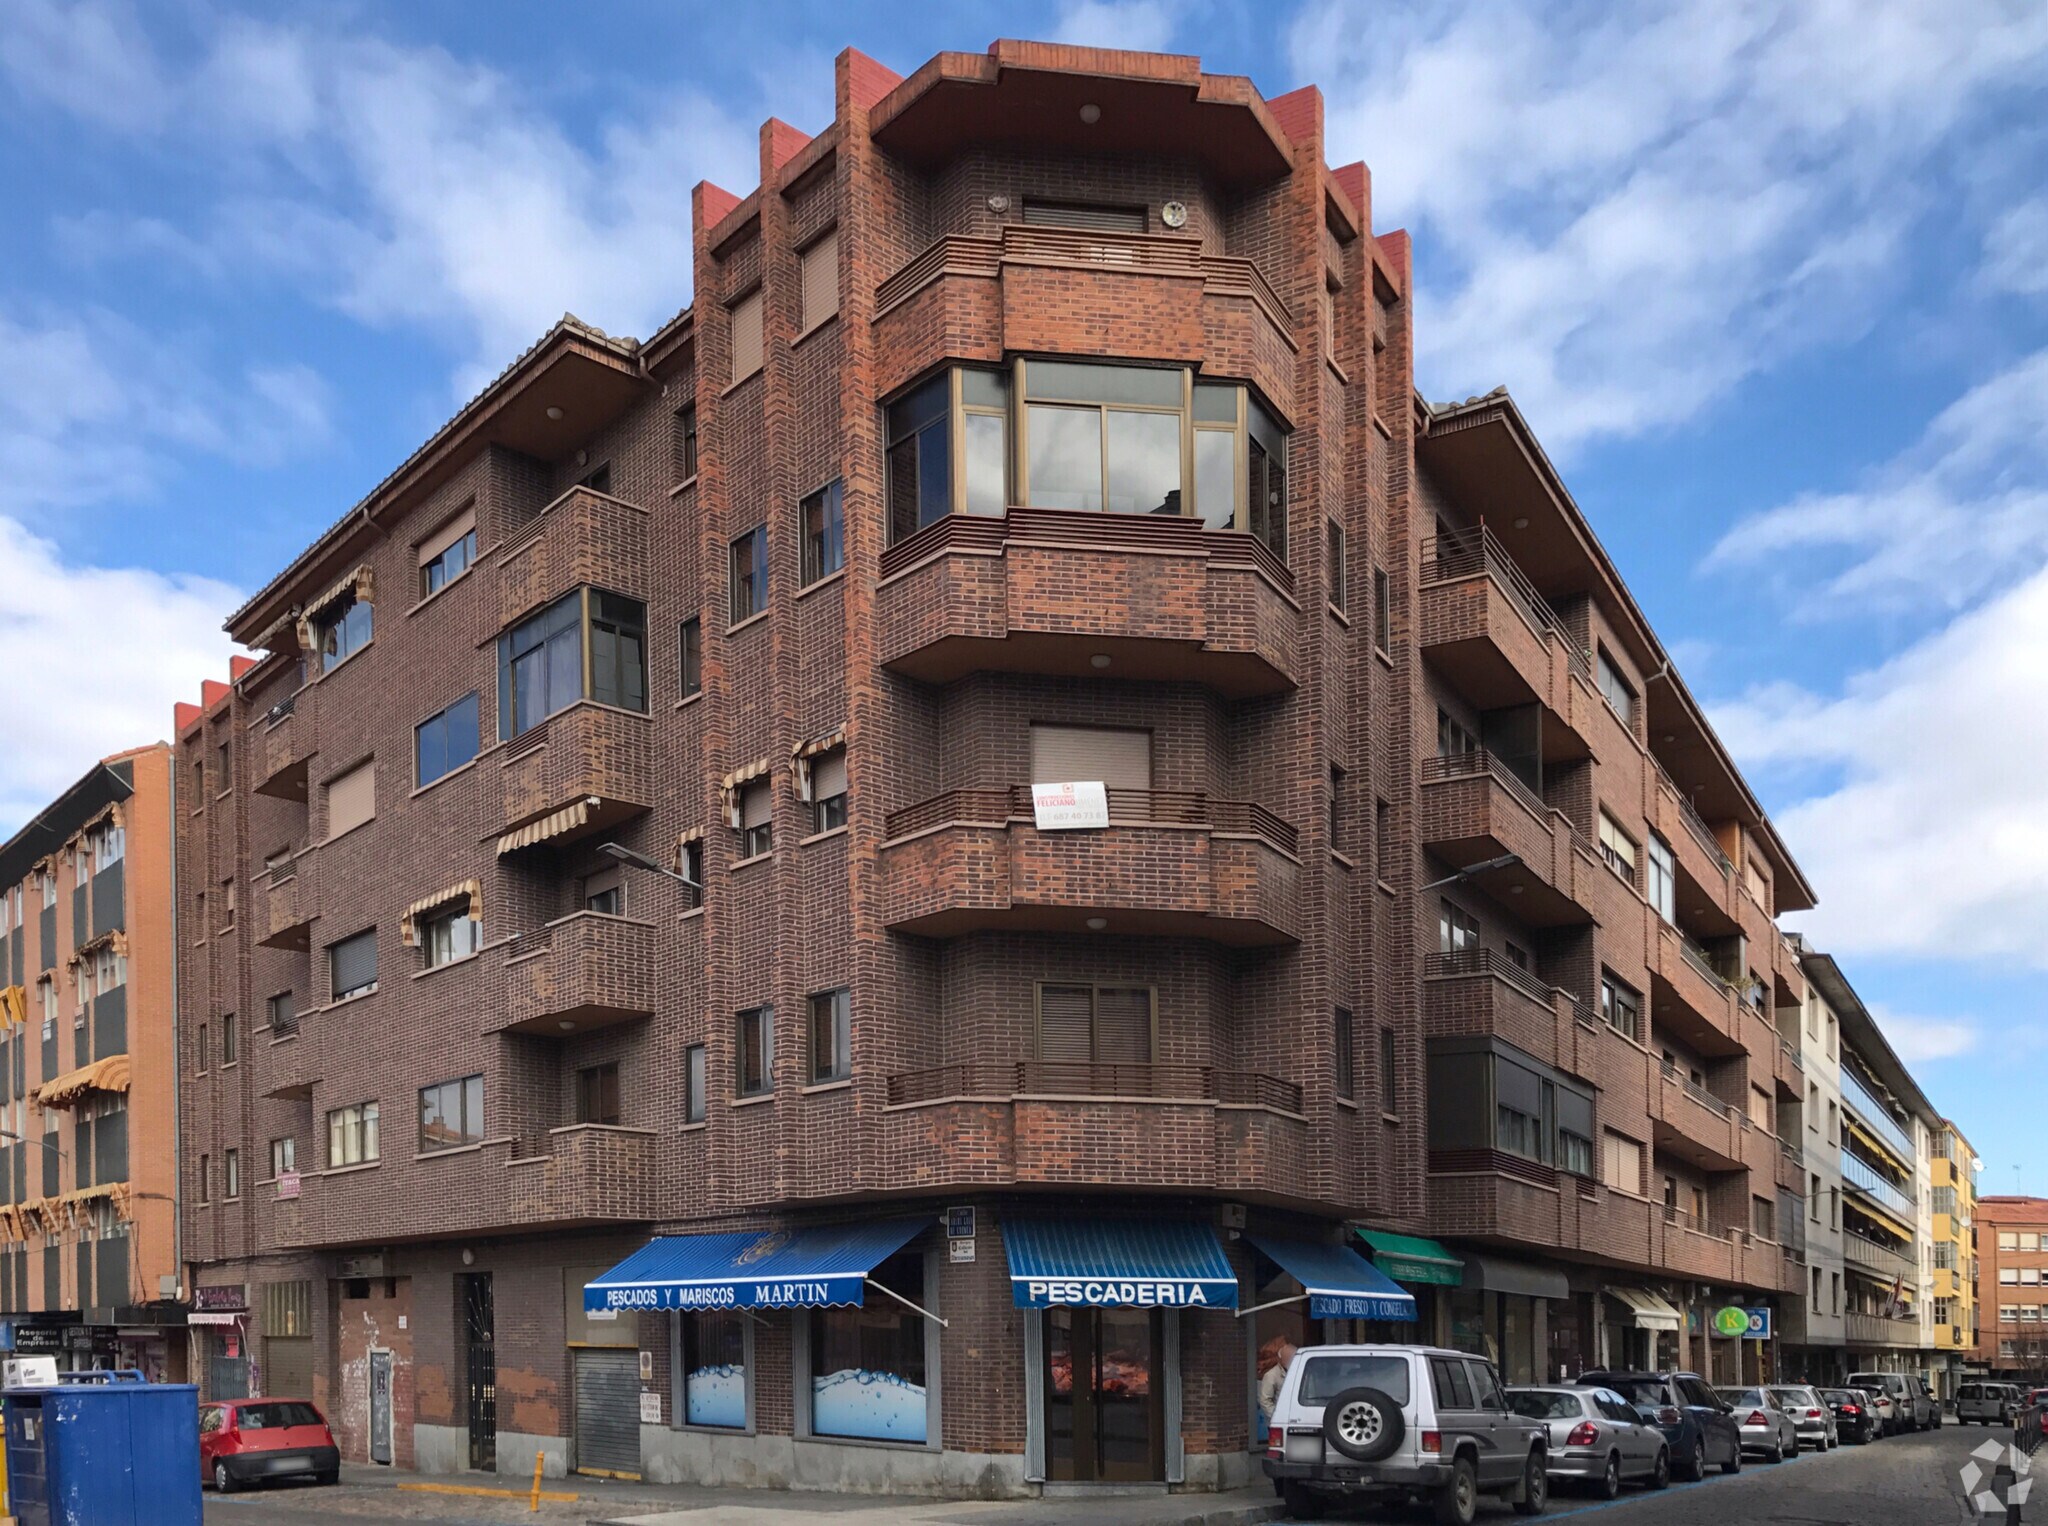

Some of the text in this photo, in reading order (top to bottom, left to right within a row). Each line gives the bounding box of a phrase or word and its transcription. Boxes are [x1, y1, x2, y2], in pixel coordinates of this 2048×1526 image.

[1037, 799, 1076, 807] FELICIANO
[607, 1283, 829, 1306] PESCADOS Y MARISCOS MARTIN
[1029, 1282, 1208, 1304] PESCADERIA
[1344, 1298, 1369, 1315] FRESCO
[1725, 1312, 1739, 1328] K
[1752, 1318, 1760, 1327] K
